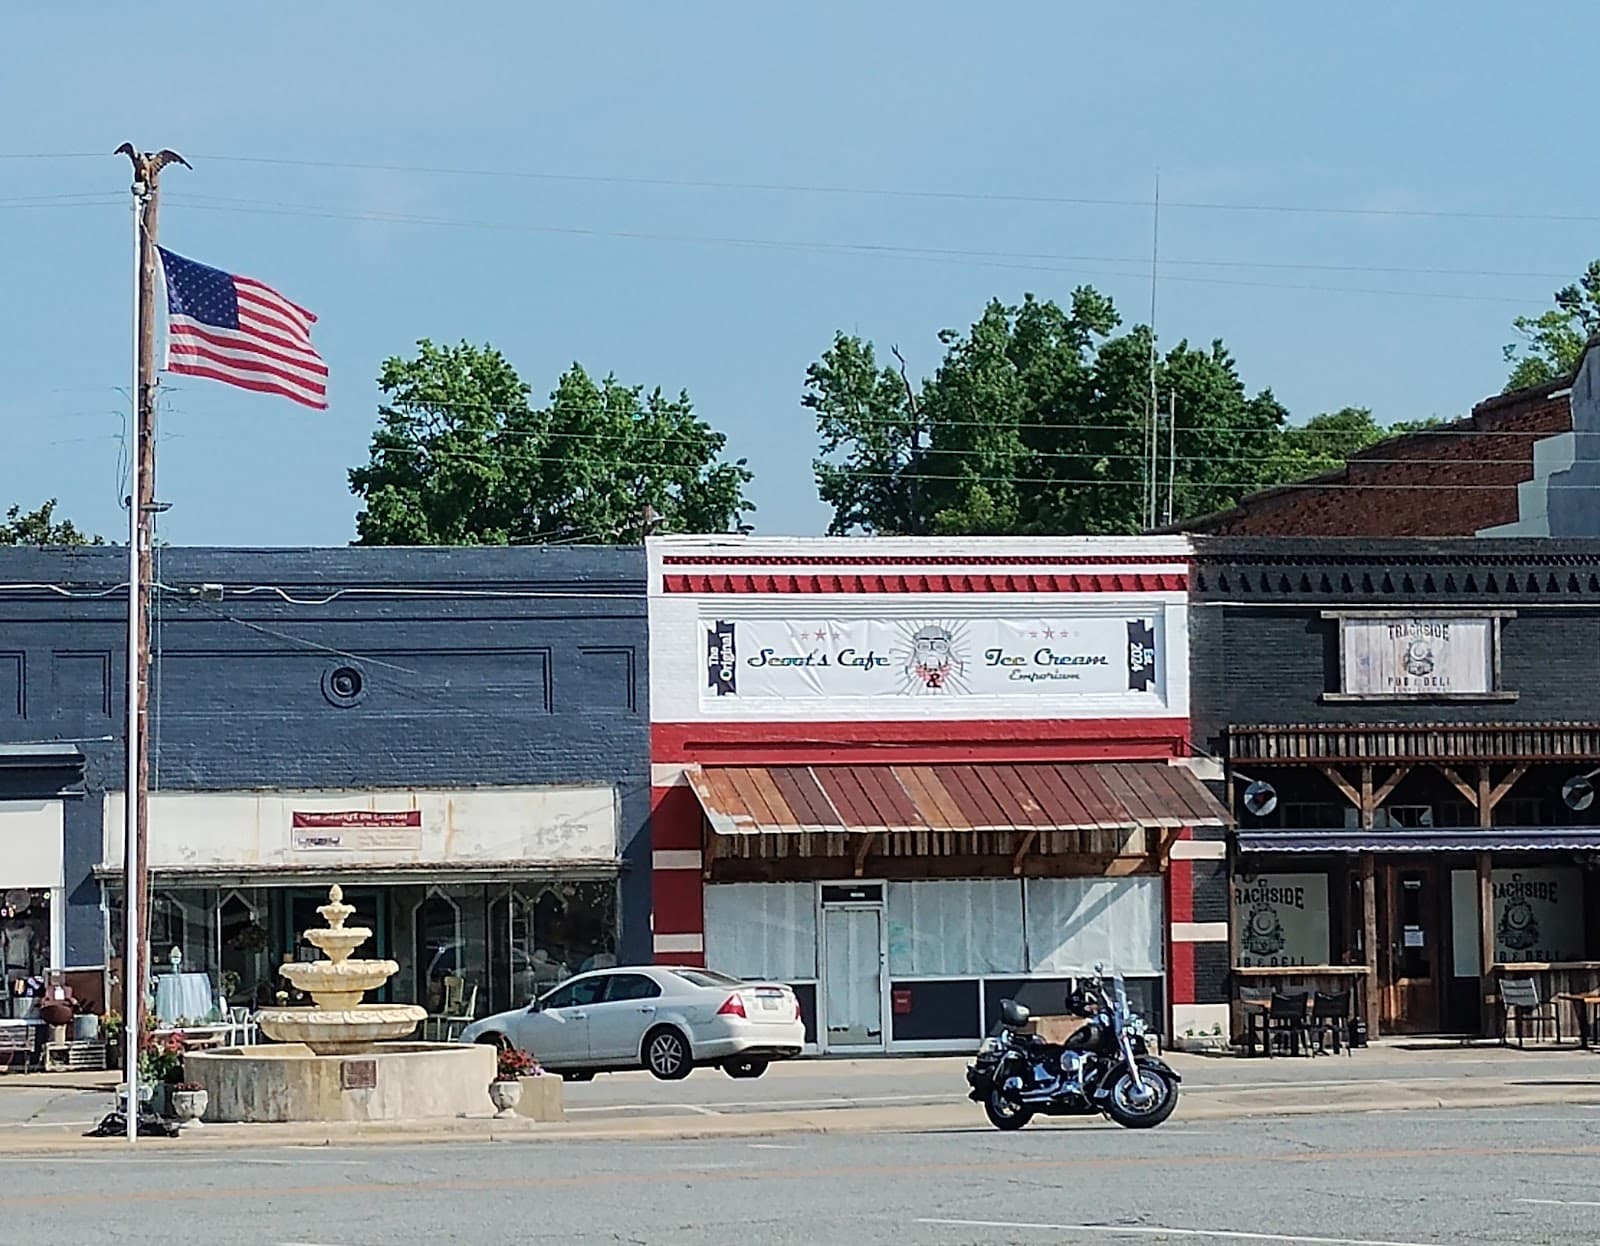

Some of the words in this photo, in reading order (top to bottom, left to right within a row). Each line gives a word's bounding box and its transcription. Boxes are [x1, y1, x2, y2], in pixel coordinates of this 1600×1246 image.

[709, 646, 719, 666] The
[719, 632, 735, 681] Original
[837, 648, 891, 671] Cafe
[984, 648, 1027, 666] Ice
[1034, 648, 1109, 666] Cream
[1130, 642, 1144, 673] 2024
[1008, 668, 1080, 683] Emporium
[1423, 676, 1450, 687] DELI
[1234, 887, 1304, 910] RACKSIDE
